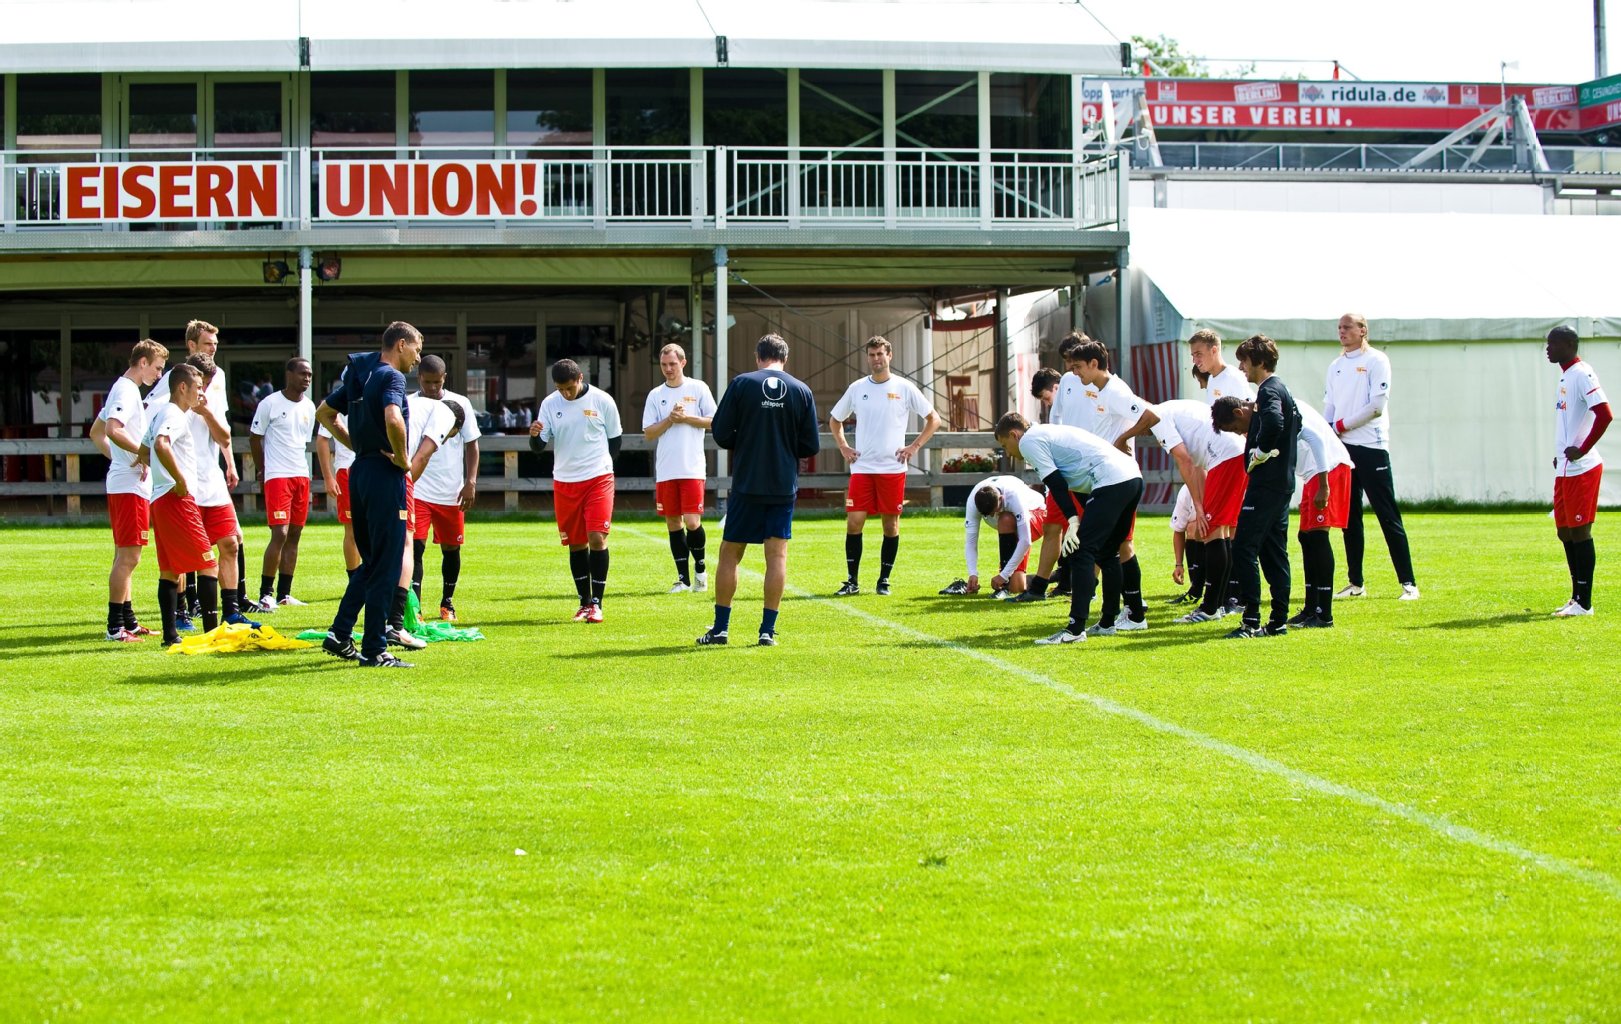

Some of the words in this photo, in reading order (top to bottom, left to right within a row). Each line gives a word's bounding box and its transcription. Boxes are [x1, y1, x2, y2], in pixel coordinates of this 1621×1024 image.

[1331, 86, 1416, 102] ridula.de
[1154, 106, 1236, 124] UNSER
[1249, 107, 1353, 127] VEREIN.
[67, 164, 277, 219] EISERN
[326, 163, 538, 217] UNION!
[761, 400, 785, 408] uhlsport
